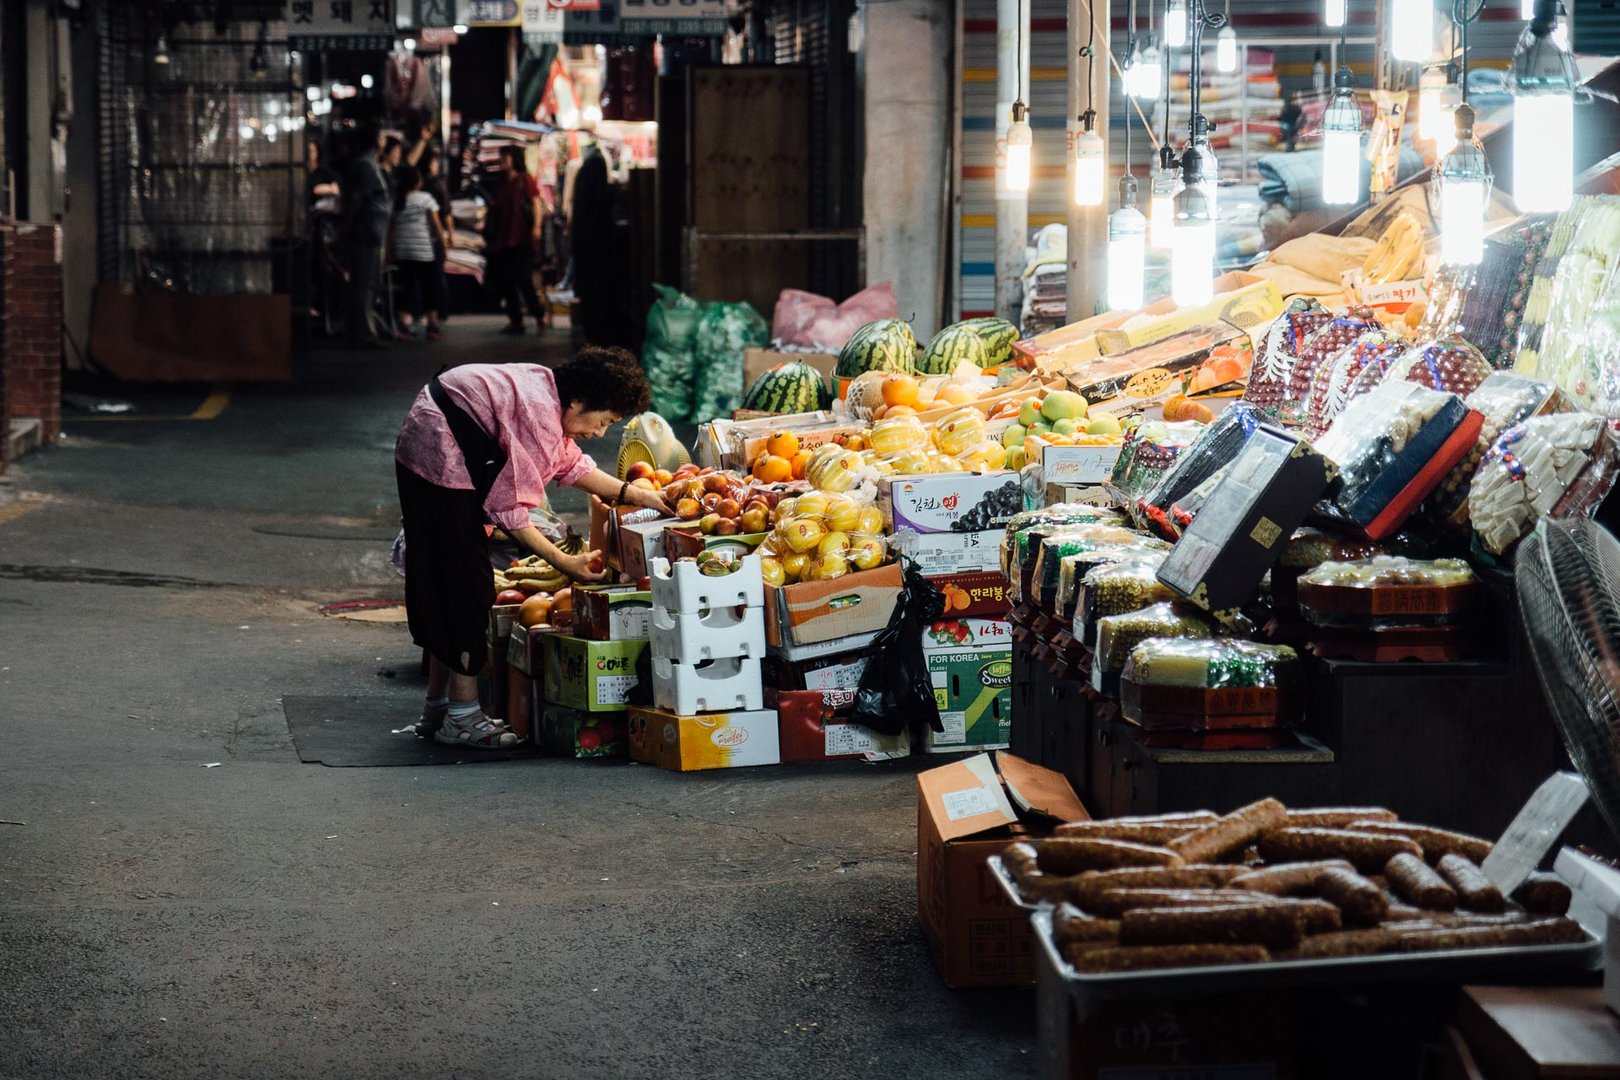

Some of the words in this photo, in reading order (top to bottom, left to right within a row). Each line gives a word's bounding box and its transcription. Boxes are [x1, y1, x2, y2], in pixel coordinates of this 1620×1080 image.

[1392, 287, 1416, 301] 딸기
[970, 587, 1004, 603] 한라봉
[930, 655, 948, 664] FOR
[949, 653, 979, 663] KOREA
